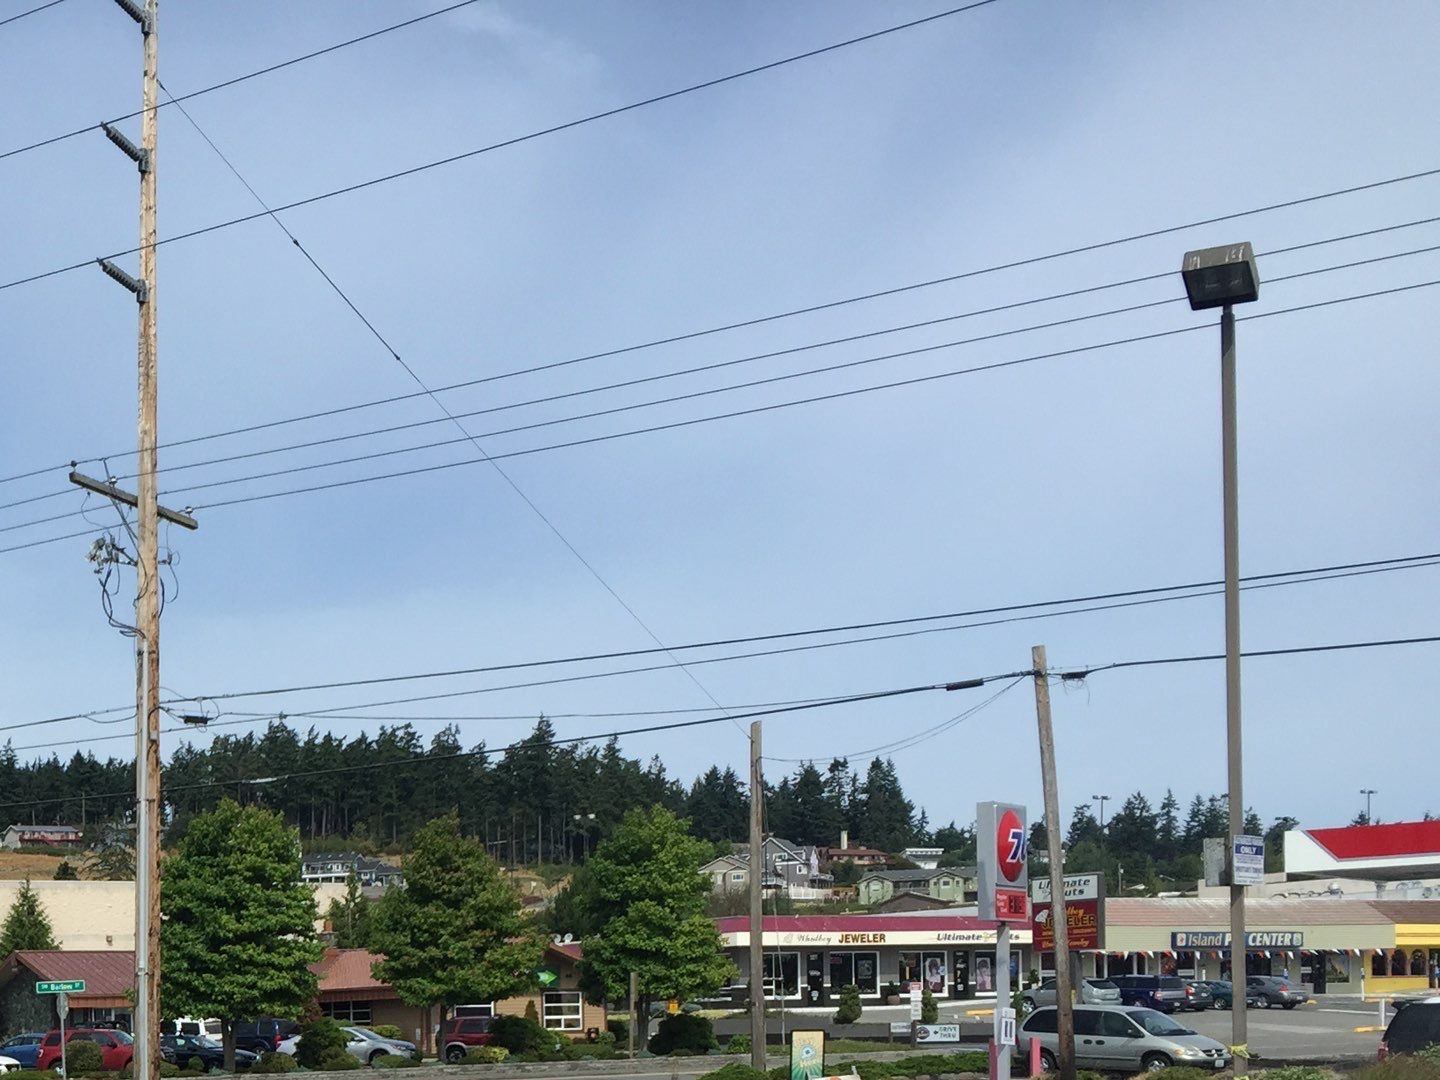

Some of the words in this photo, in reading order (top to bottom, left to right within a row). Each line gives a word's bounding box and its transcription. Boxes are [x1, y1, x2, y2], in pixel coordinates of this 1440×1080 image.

[1043, 914, 1096, 929] JEELER
[839, 933, 886, 943] JEWELER
[936, 933, 982, 941] Ultimate
[1188, 933, 1222, 946] Island
[1248, 933, 1292, 946] CENTER
